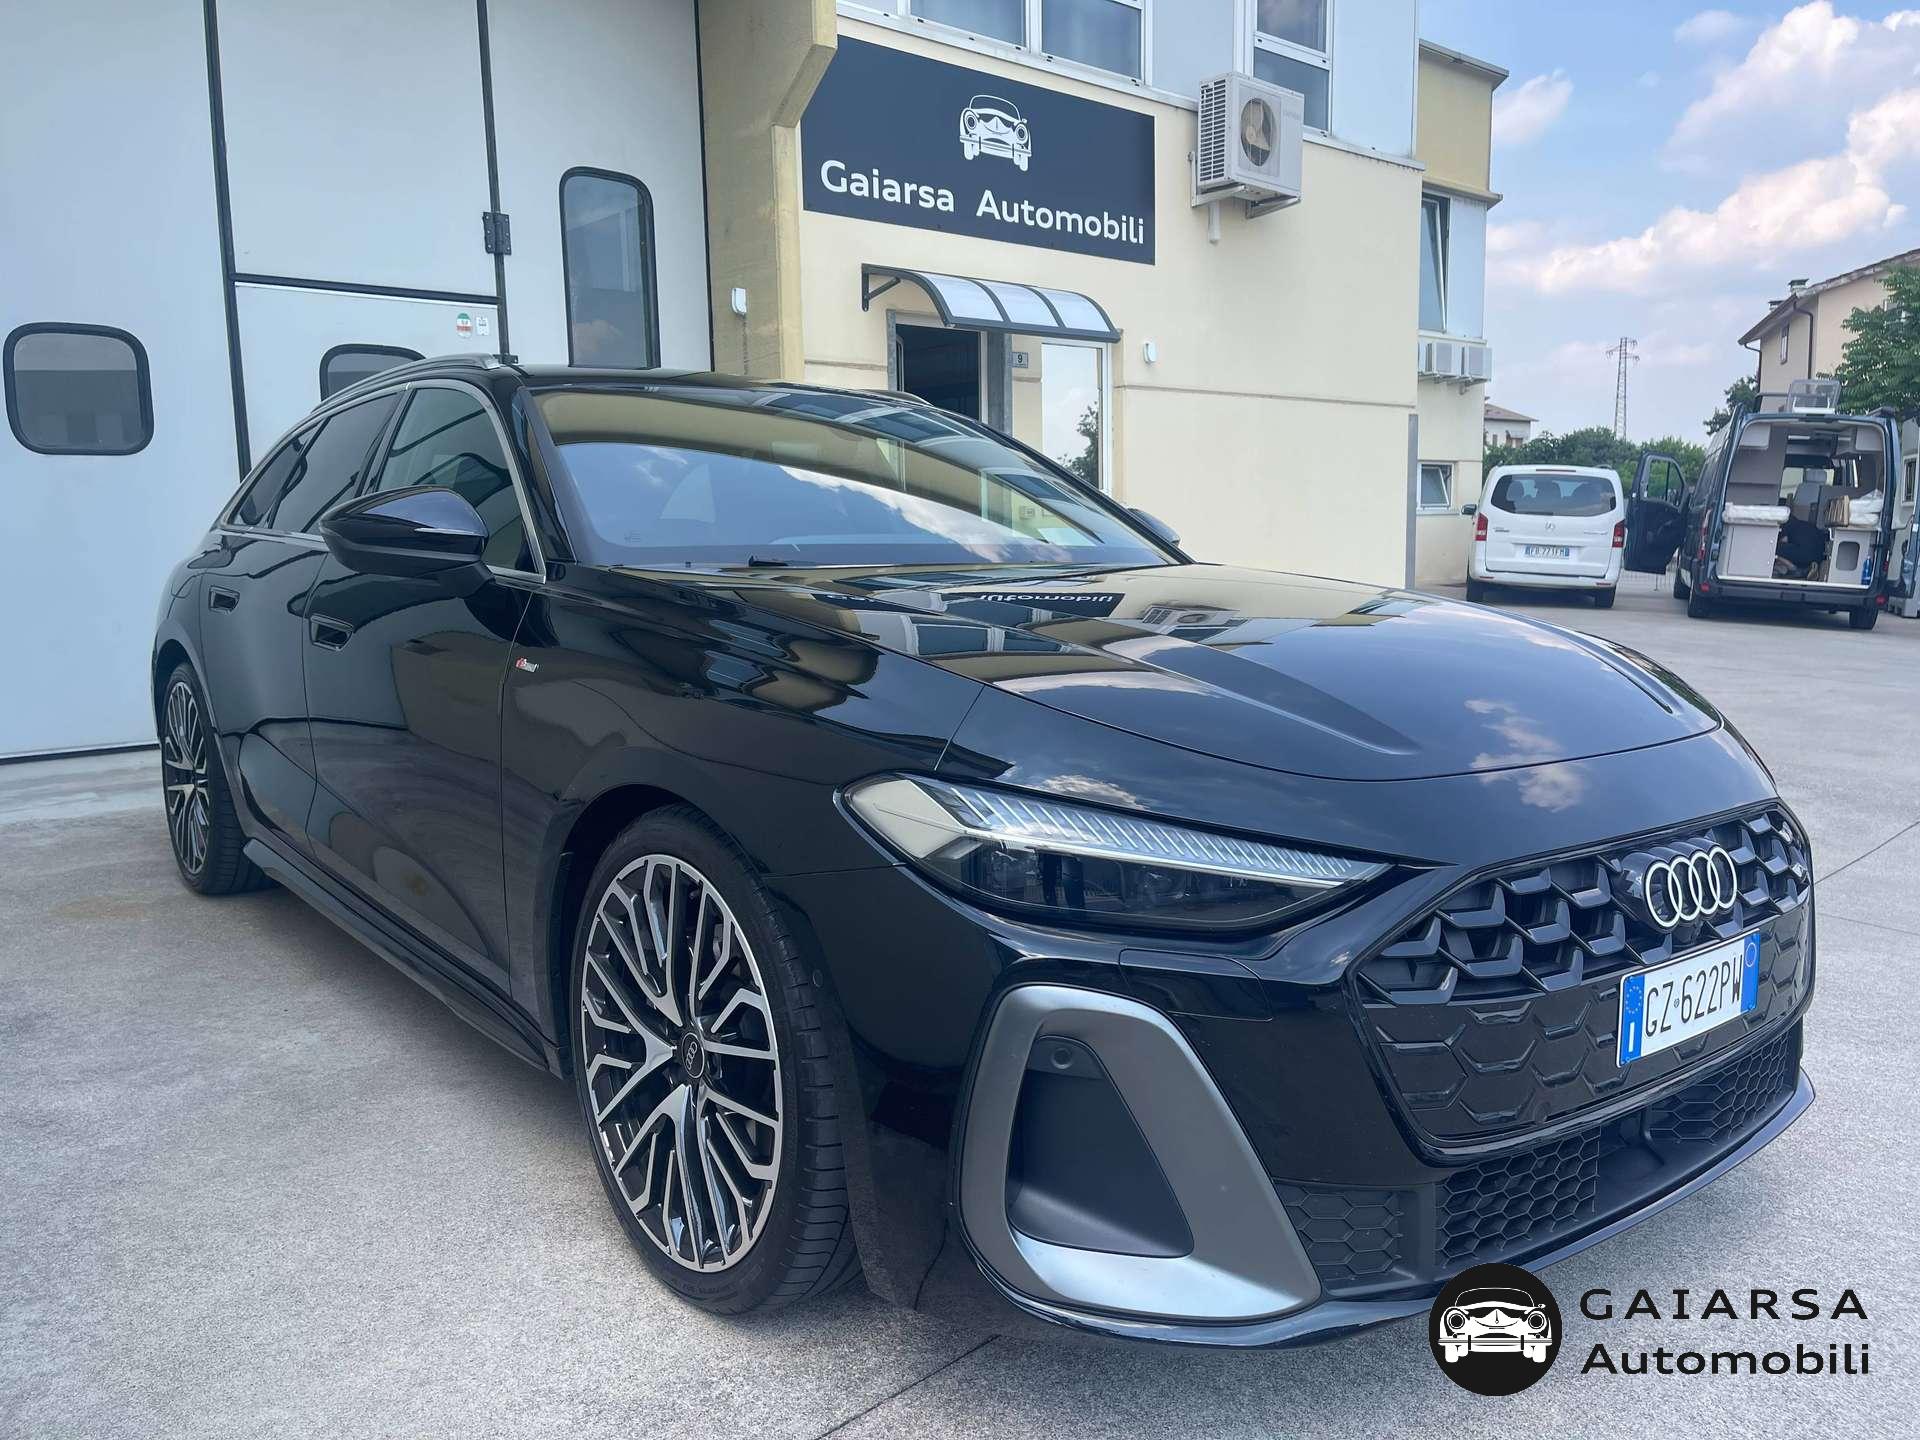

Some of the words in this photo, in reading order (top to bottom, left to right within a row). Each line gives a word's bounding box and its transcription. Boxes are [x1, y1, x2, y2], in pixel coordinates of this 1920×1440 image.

[820, 159, 955, 212] Gaiarsa
[976, 190, 1144, 244] Automobili
[1017, 354, 1023, 364] 9
